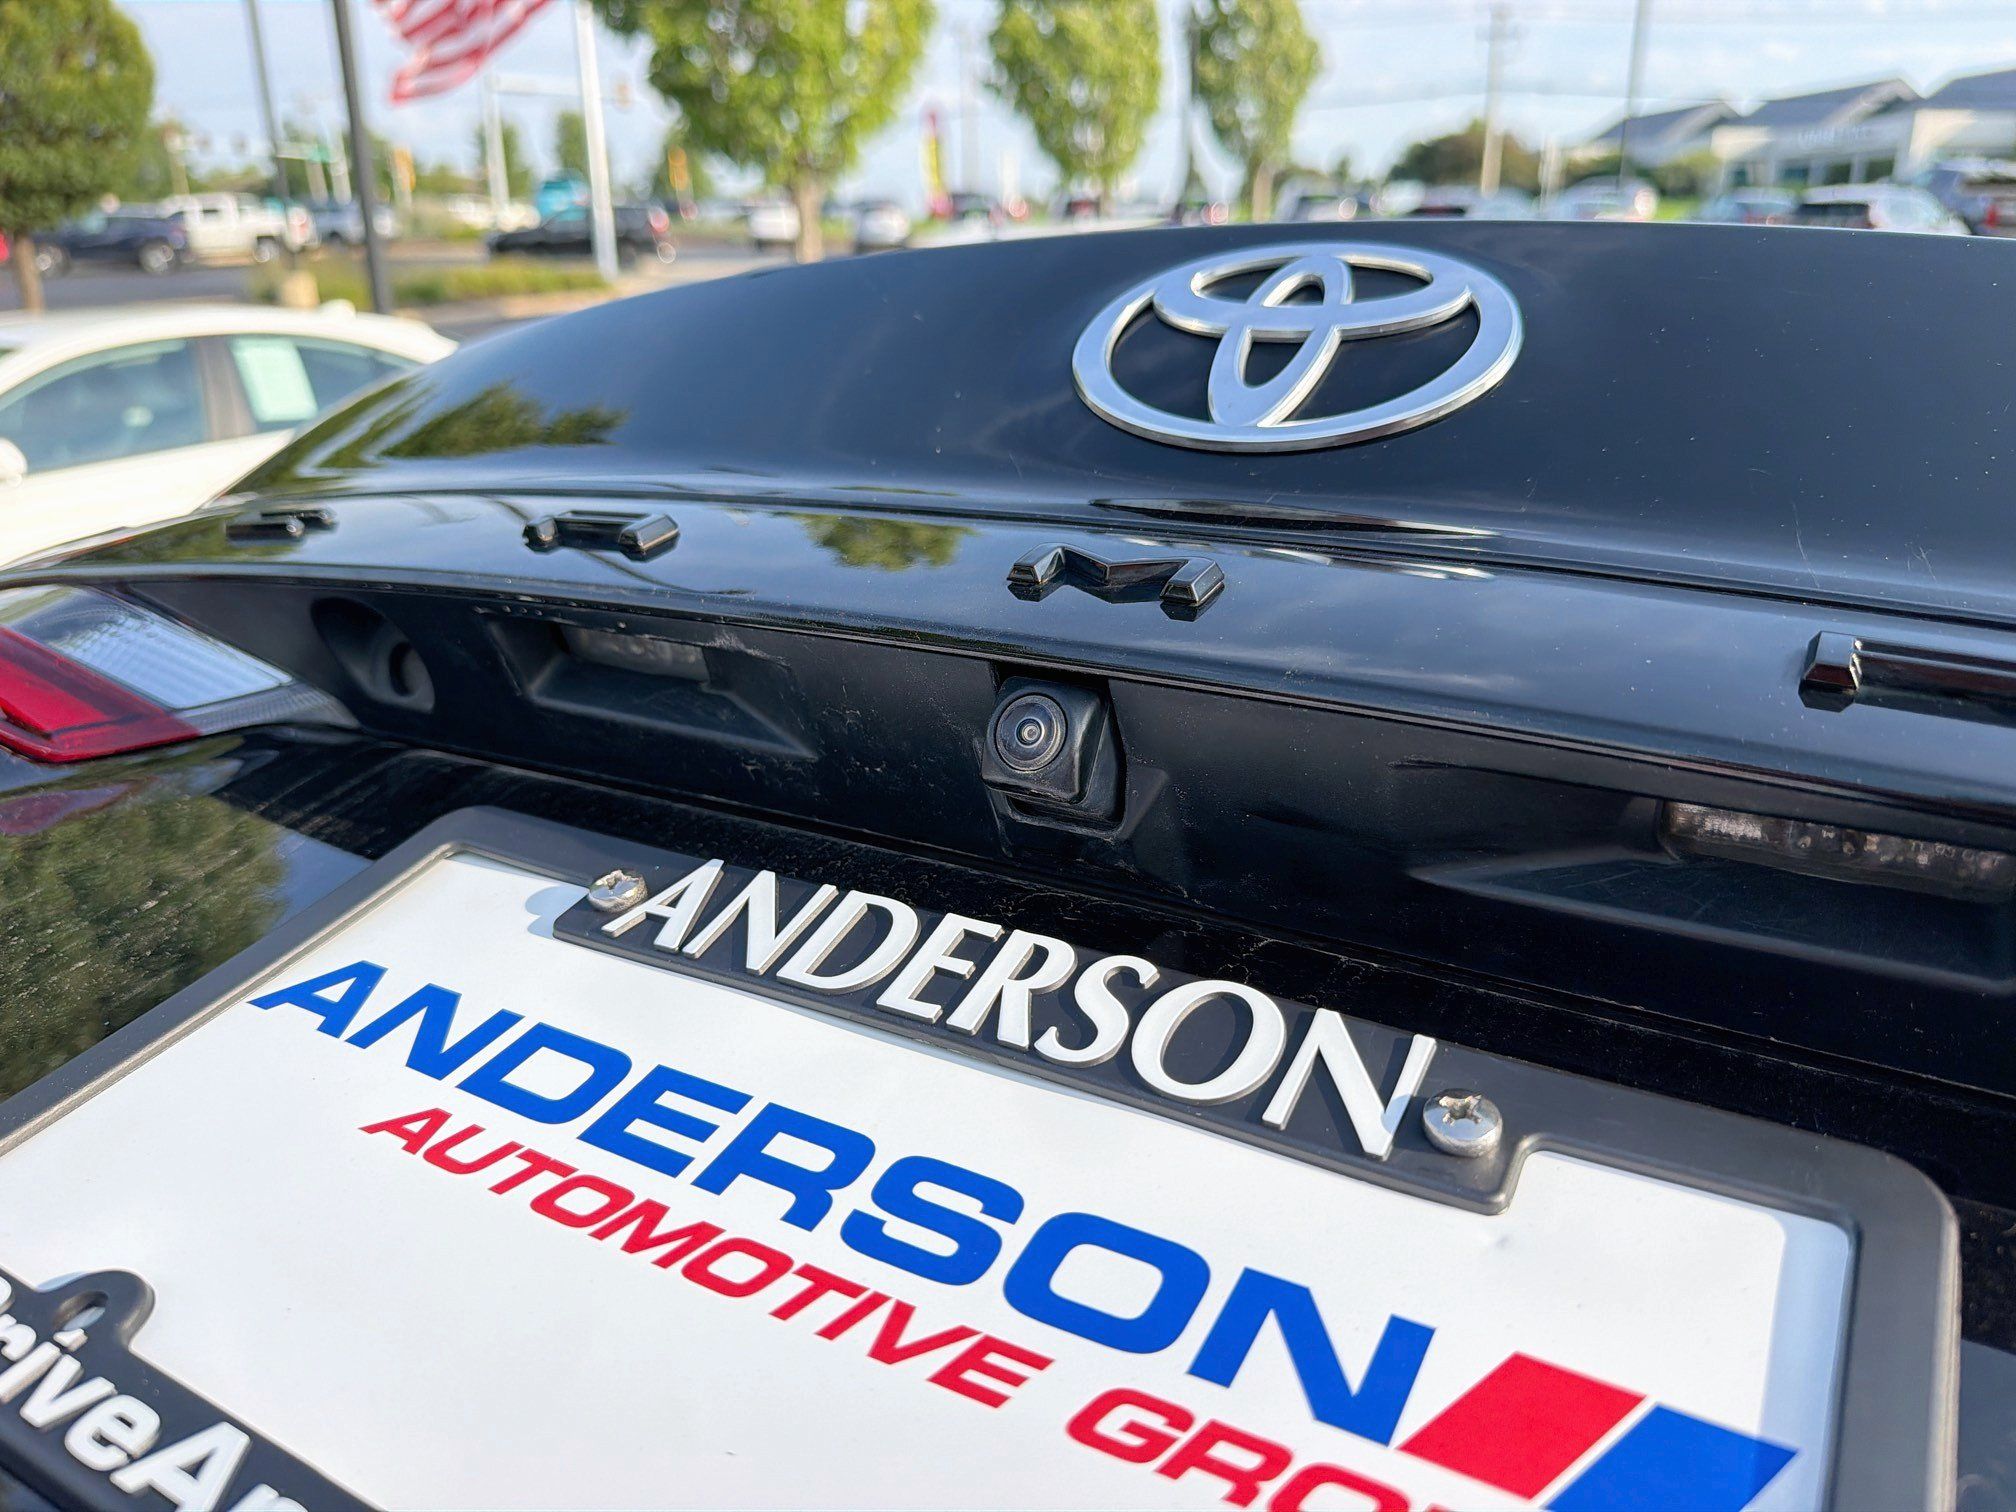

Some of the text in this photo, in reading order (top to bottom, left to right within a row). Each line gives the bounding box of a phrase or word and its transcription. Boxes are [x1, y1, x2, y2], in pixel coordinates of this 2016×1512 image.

[601, 858, 1438, 1161] ANDERSON
[250, 961, 1436, 1447] ANDERSON
[362, 1107, 1448, 1512] AUTOMOTIVE GRO
[0, 1274, 309, 1512] riveA
